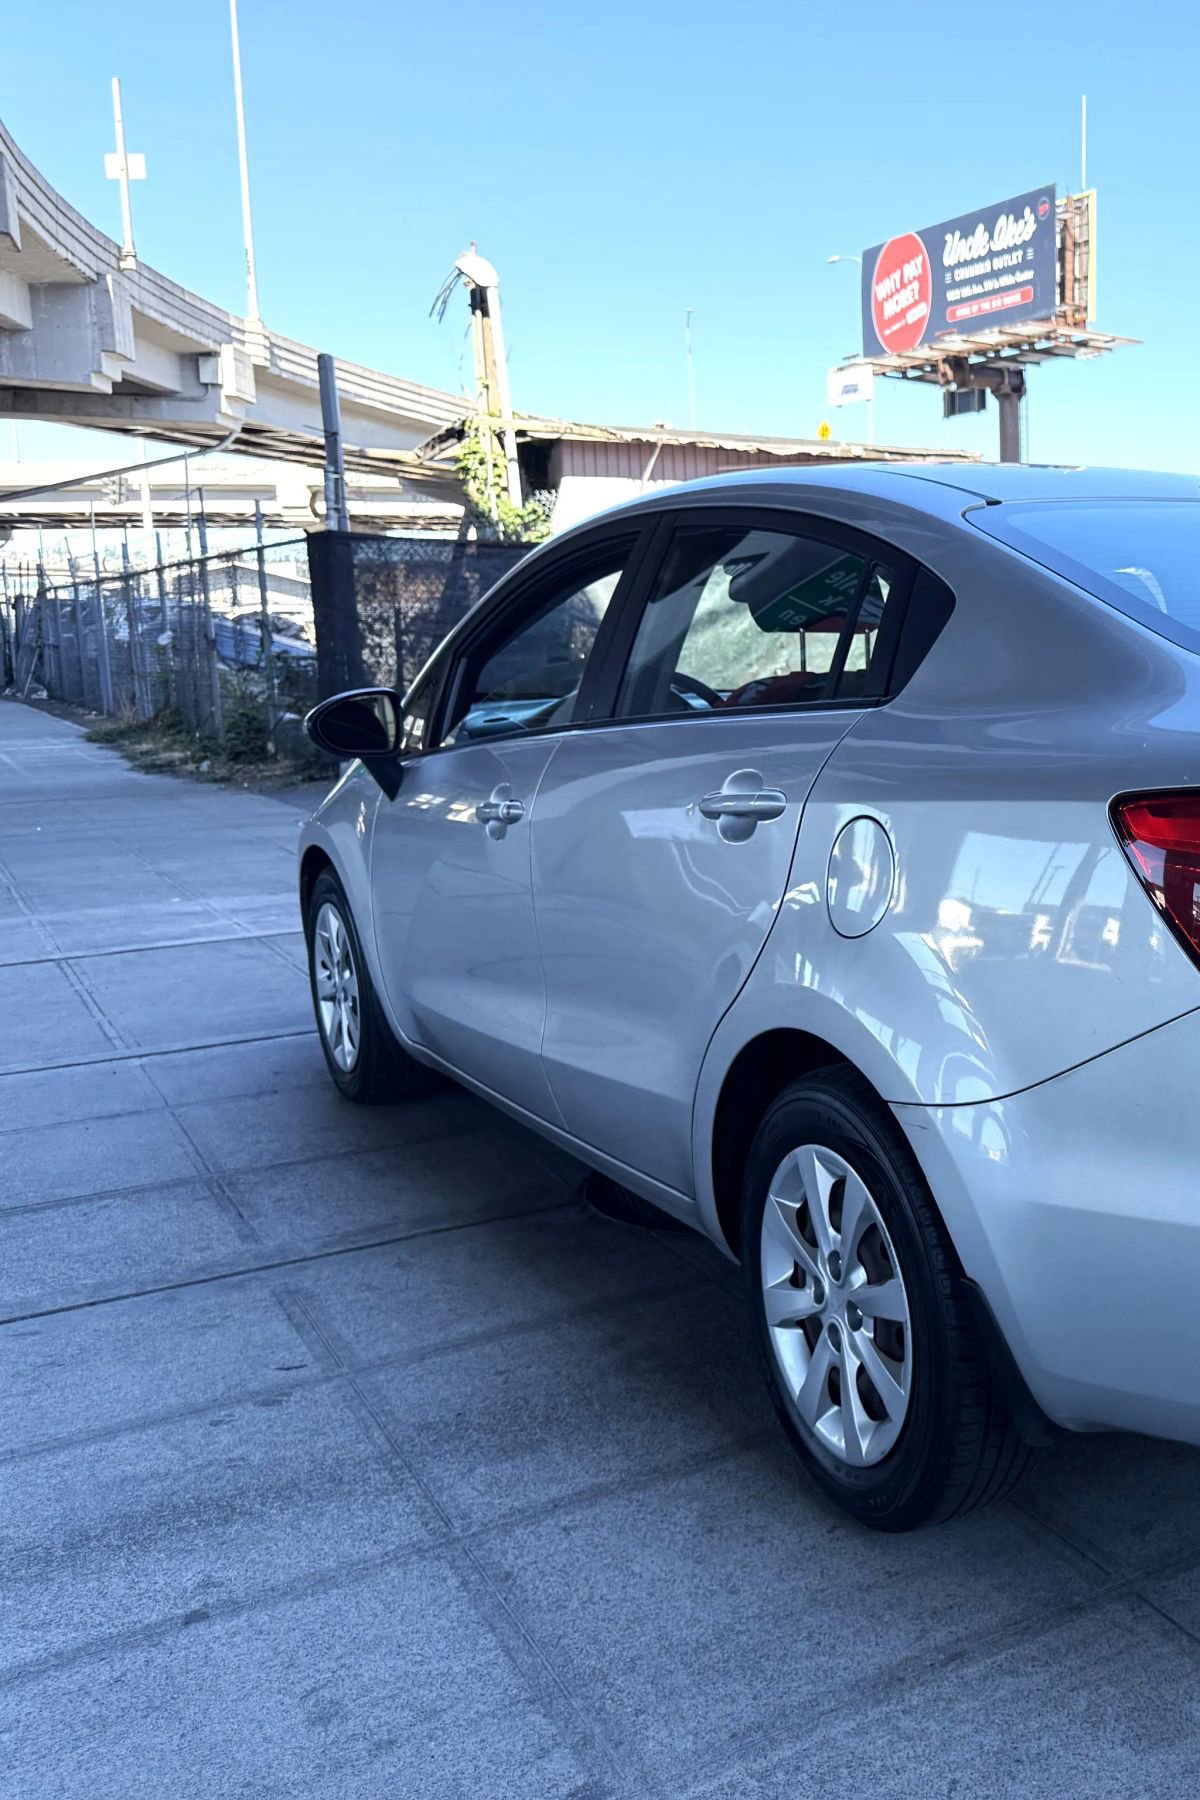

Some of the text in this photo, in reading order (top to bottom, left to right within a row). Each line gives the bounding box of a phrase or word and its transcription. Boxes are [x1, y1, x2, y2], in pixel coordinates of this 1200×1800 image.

[942, 222, 990, 267] Uncle
[875, 254, 924, 302] WHY PAY
[883, 281, 919, 321] MORE?
